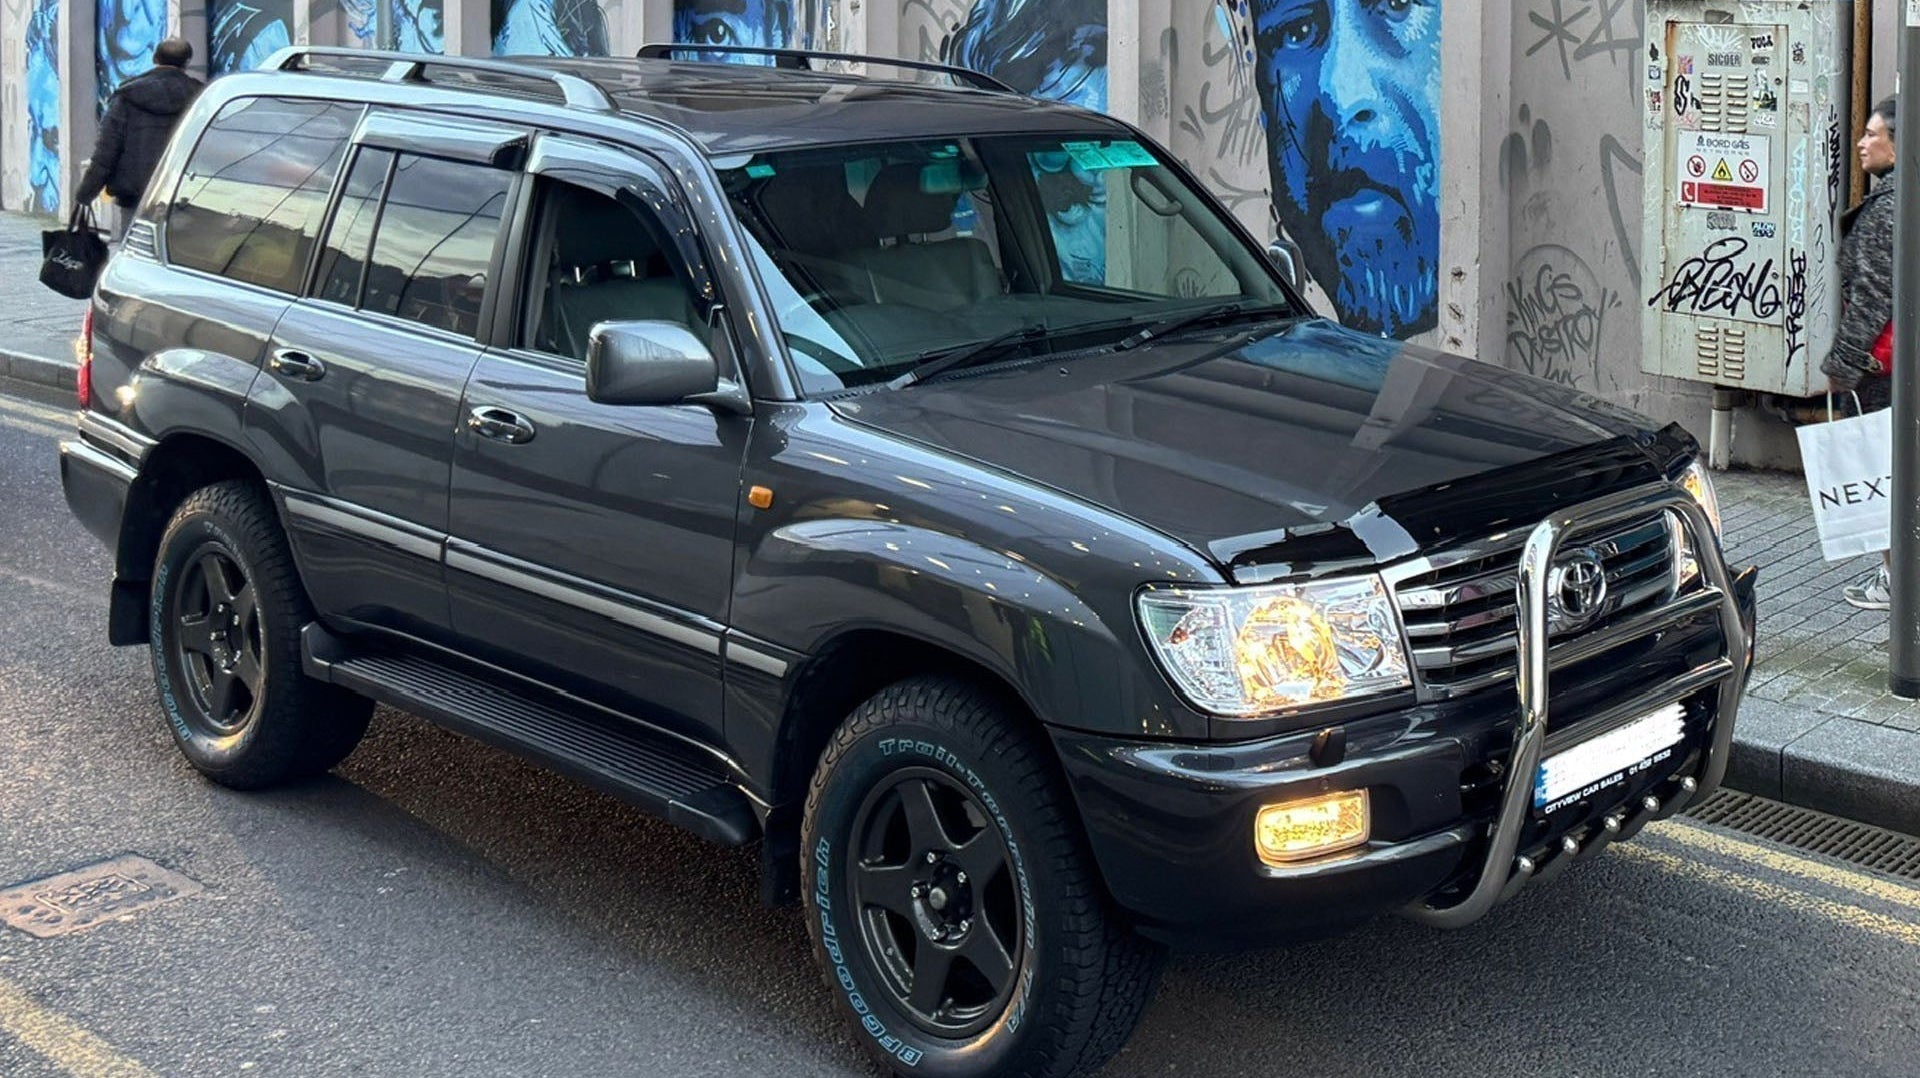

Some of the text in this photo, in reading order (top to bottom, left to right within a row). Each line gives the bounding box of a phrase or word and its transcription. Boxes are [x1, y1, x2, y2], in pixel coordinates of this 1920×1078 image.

[1706, 138, 1730, 148] BORD
[1544, 791, 1582, 814] CITYVIEW
[1583, 783, 1599, 797] CAR
[1600, 772, 1624, 789] SALES
[815, 837, 924, 1067] BFGoodrich
